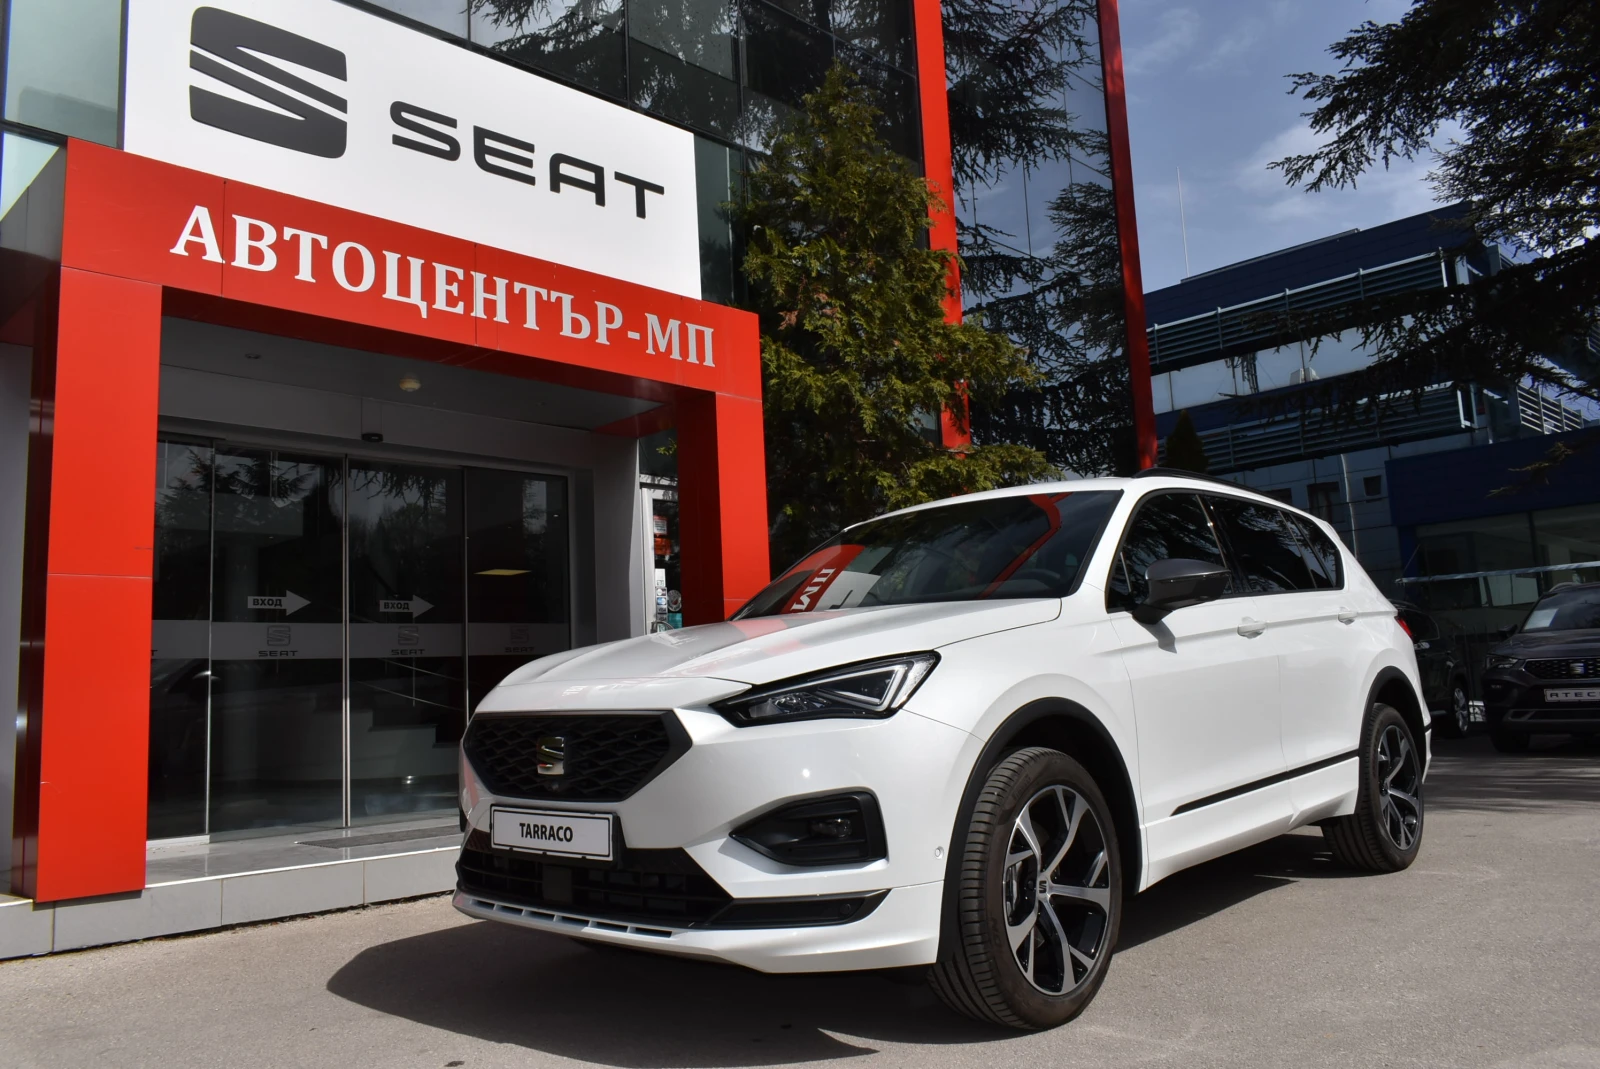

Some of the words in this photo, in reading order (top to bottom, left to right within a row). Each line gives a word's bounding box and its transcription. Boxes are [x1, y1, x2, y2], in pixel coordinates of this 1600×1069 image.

[390, 101, 665, 219] SEAT
[170, 205, 716, 368] АВТОЦЕНТЪР-МП
[252, 598, 283, 607] ВХОД
[383, 602, 410, 610] ВХОД
[391, 648, 425, 656] SEAT
[519, 822, 573, 842] TARRACO
